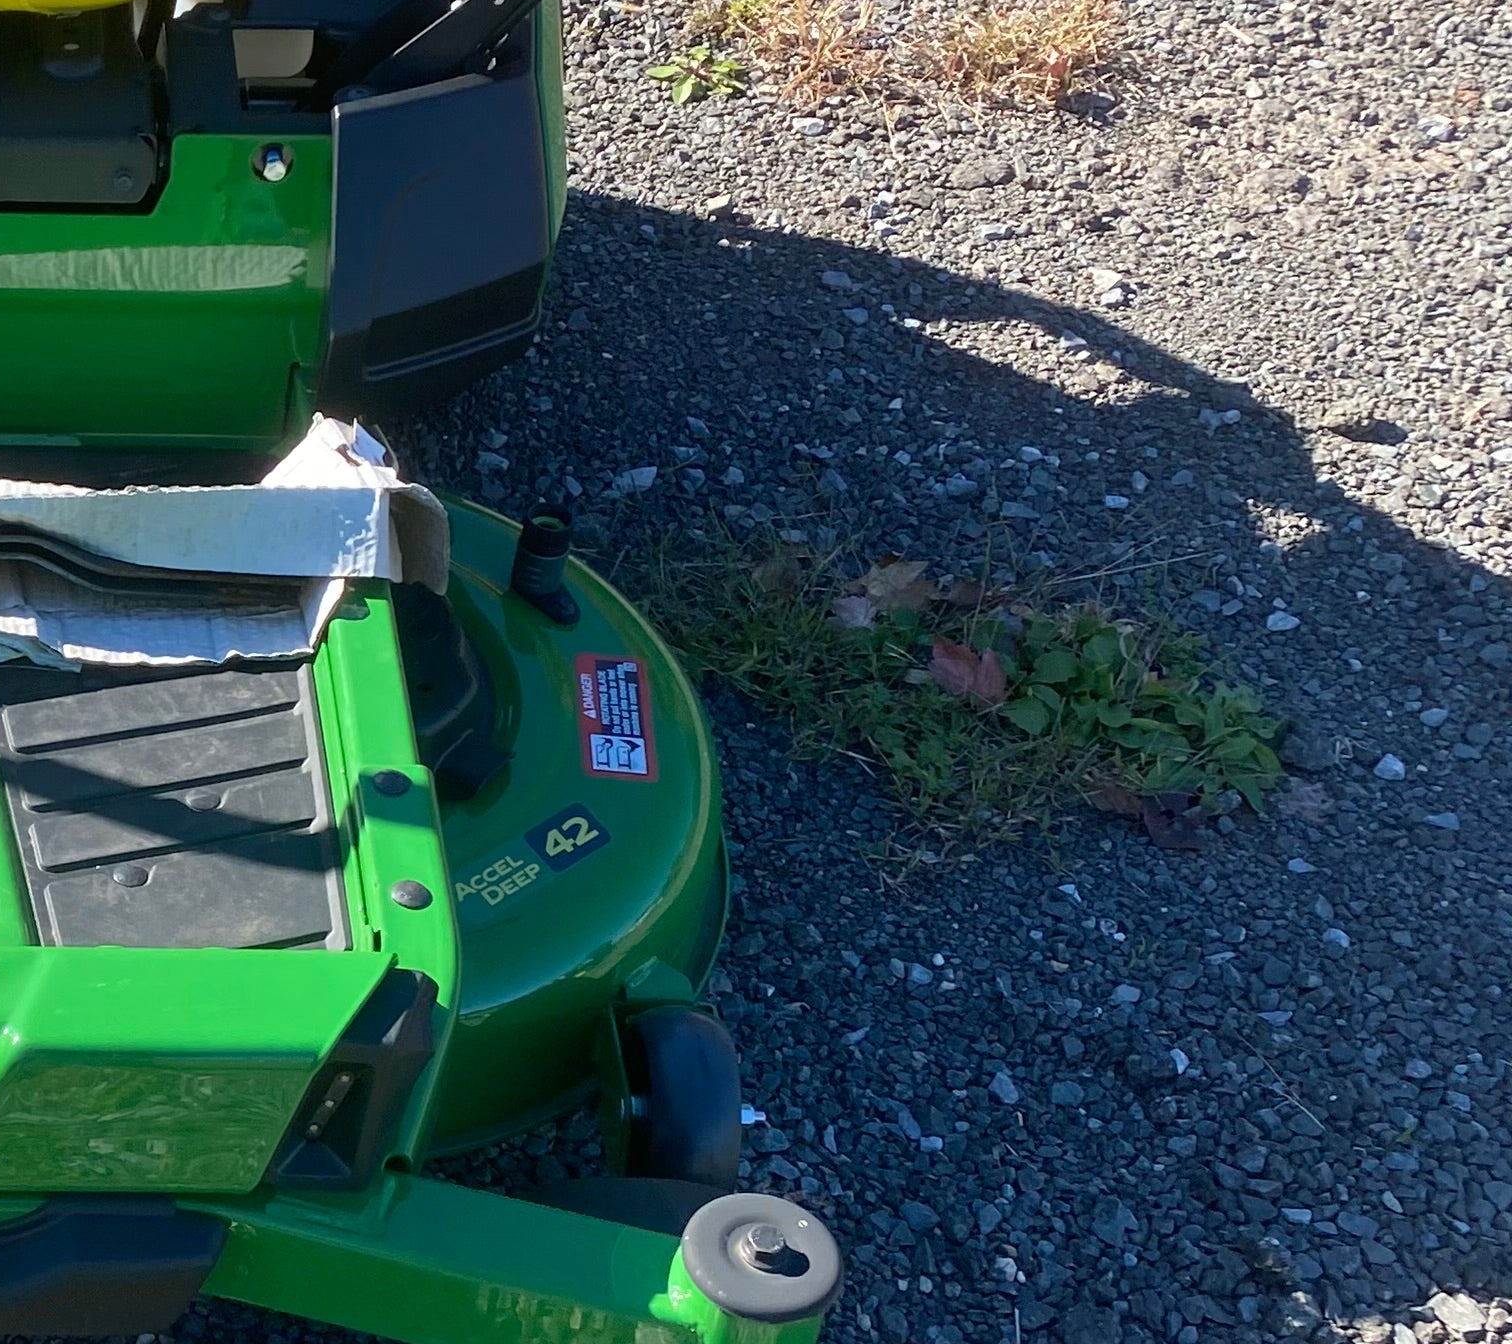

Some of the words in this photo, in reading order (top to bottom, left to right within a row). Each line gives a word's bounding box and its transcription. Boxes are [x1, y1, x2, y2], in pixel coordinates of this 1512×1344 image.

[580, 673, 594, 708] DANGER
[544, 816, 600, 859] 42
[455, 855, 525, 902] ACCEL
[479, 863, 541, 906] DEEP
